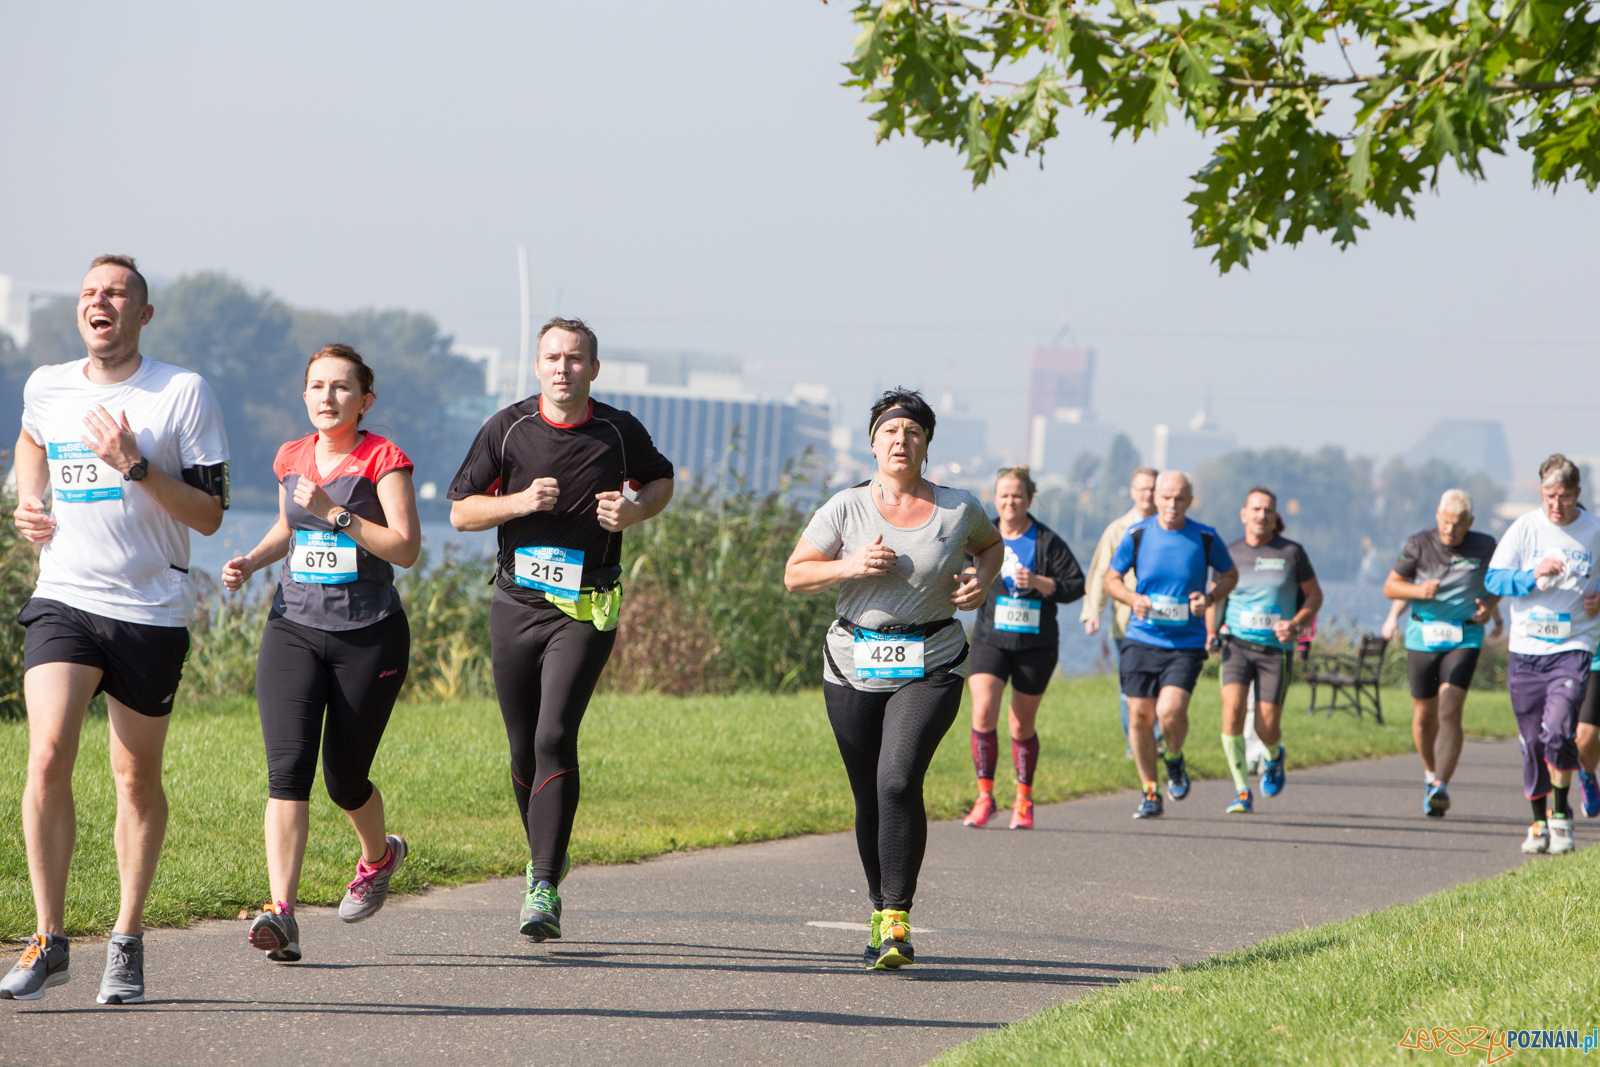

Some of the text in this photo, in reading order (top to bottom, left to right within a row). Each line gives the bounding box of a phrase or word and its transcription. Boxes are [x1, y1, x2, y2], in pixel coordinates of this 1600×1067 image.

[57, 442, 90, 452] zaBIEG
[64, 451, 99, 459] FUNdusz
[61, 463, 98, 484] 673
[305, 550, 338, 569] 679
[530, 561, 564, 583] 215
[1007, 610, 1030, 623] 028
[1536, 623, 1560, 635] 268
[870, 645, 906, 663] 428
